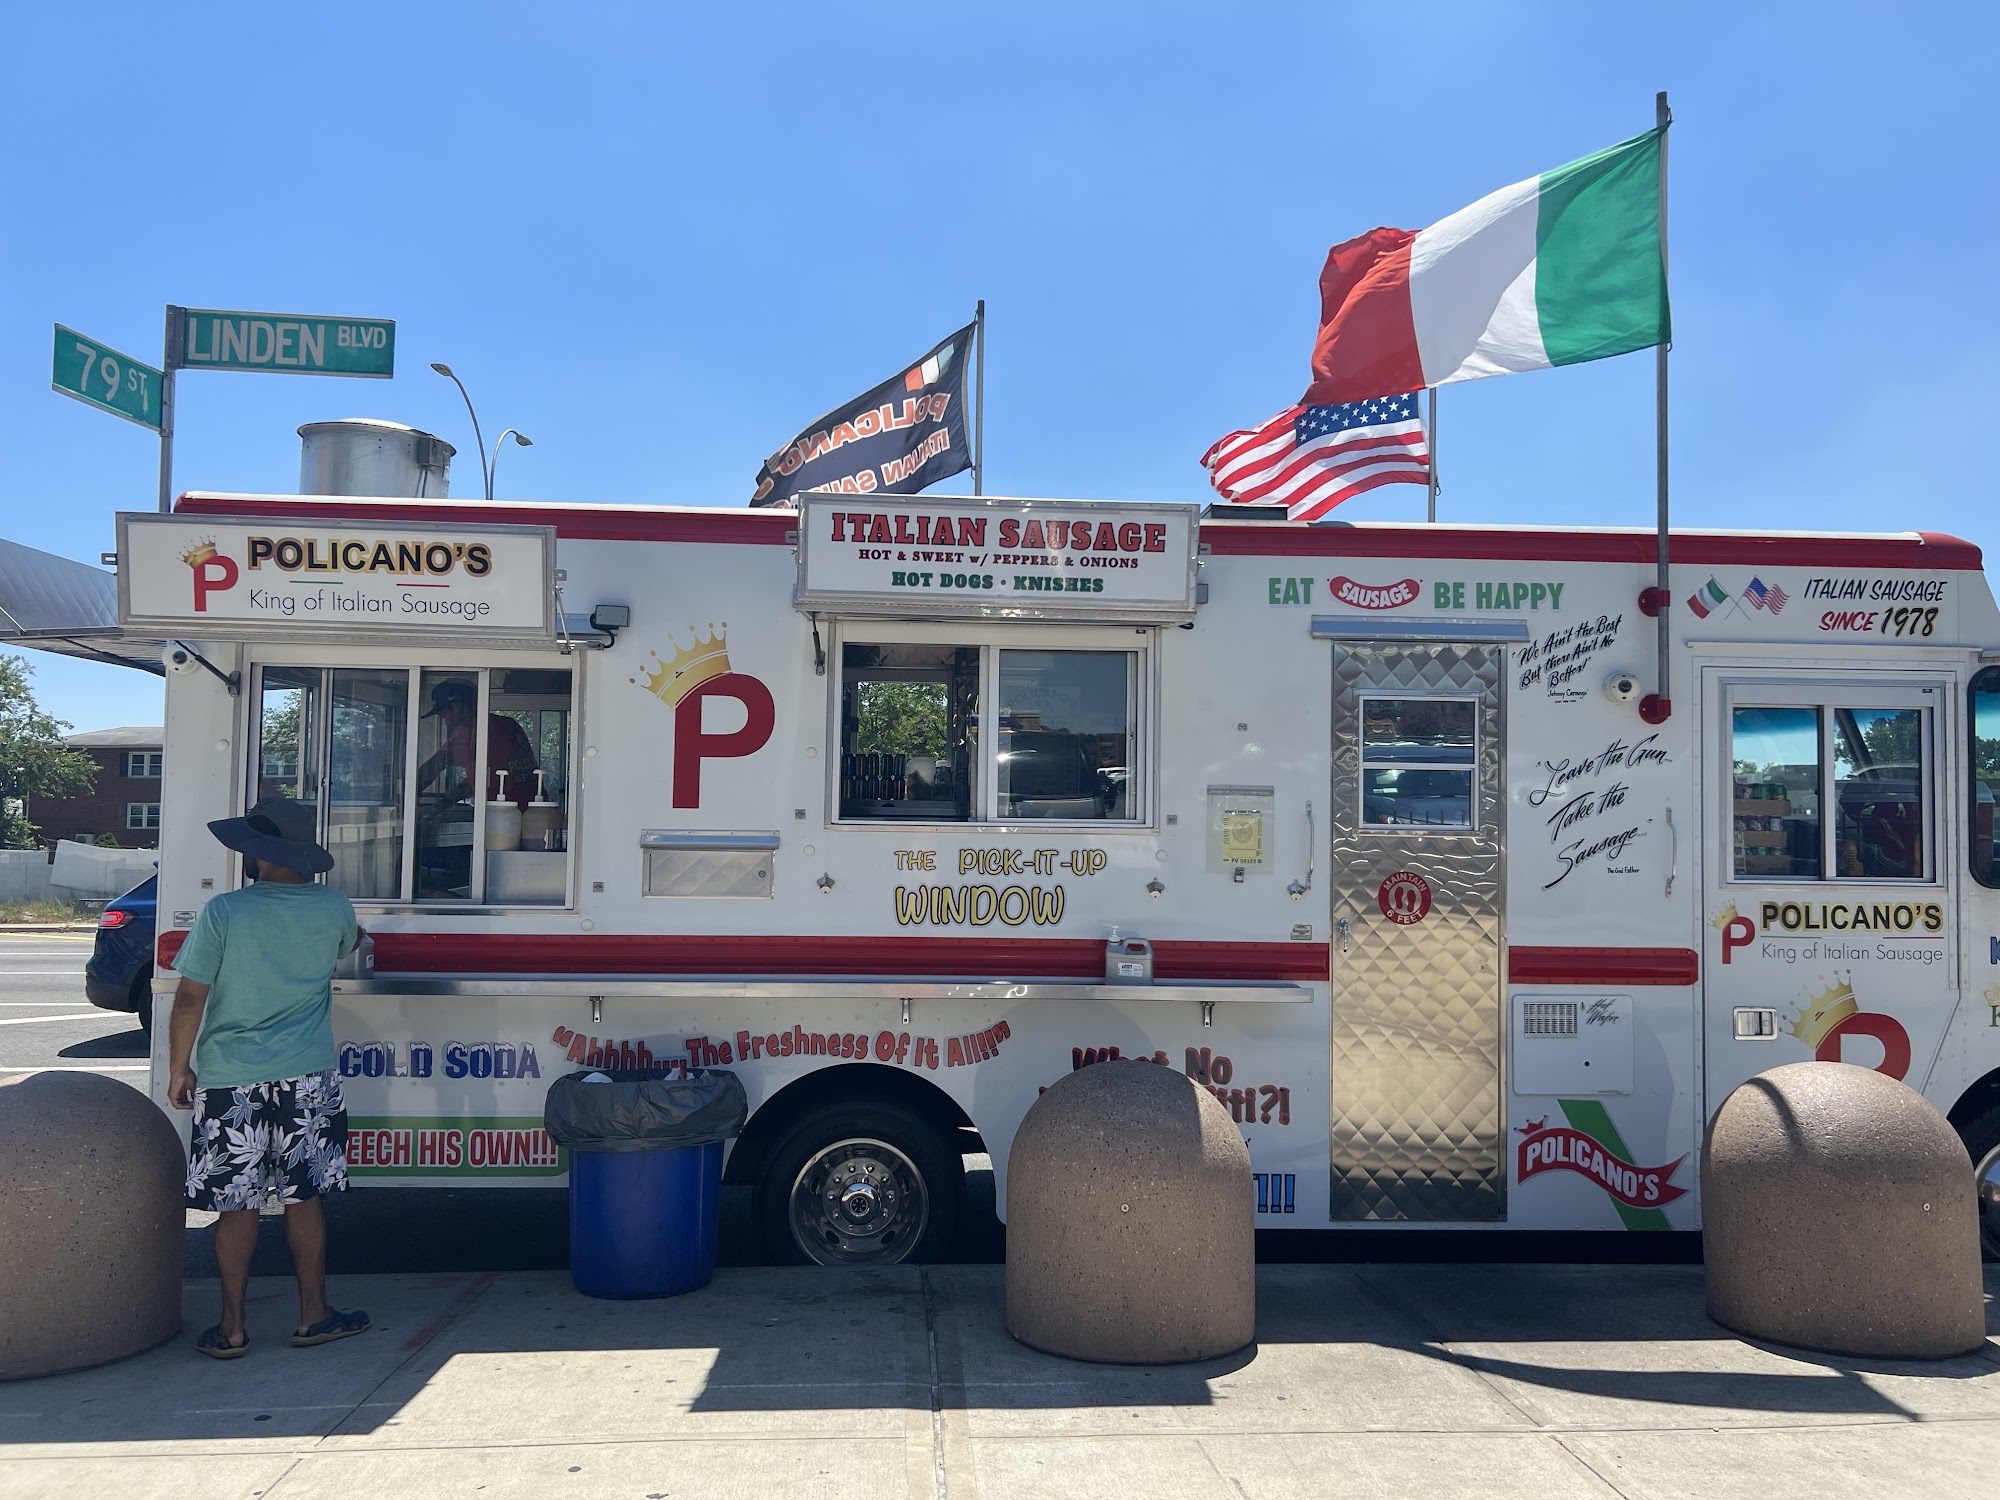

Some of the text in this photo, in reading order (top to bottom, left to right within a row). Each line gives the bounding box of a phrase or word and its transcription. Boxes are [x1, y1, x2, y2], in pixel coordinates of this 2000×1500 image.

[188, 317, 387, 367] LINDEN BLVD
[75, 342, 148, 402] 79 ST
[831, 512, 1167, 553] ITALIAN SAUSAGE
[249, 538, 491, 576] POLICANO'S
[858, 548, 1139, 569] HOT & SWEET w/ PEPPERS & ONIONS
[891, 571, 1104, 593] HOT DOGS KNISHES
[1268, 578, 1565, 610] EAT SAUSAGE BE HAPPY
[1803, 578, 1948, 602] ITALIAN SAUSAGE
[250, 589, 490, 621] King of Italian Sausage
[1818, 607, 1939, 637] SINCE 1978
[1543, 626, 1574, 653] Ain't
[1576, 621, 1595, 637] the
[1594, 614, 1622, 635] Best
[1521, 634, 1615, 688] But there Ain't No
[1596, 738, 1629, 775] the
[1548, 781, 1629, 841] Take the
[894, 848, 1107, 876] THE PICK-IT-UP
[1383, 872, 1427, 892] MAINTAIN
[895, 884, 1065, 926] WINDOW
[1386, 909, 1423, 924] 6 FEET
[1761, 902, 1943, 931] POLICANO'S
[1762, 942, 1943, 965] King of Italian Sausage
[339, 1041, 541, 1079] COLD SODA
[685, 1036, 734, 1068] The
[736, 1025, 869, 1061] Freshness
[875, 1030, 911, 1065] Of
[914, 1037, 939, 1070] It
[1184, 1047, 1233, 1085] No
[418, 1130, 462, 1166] HIS
[469, 1130, 558, 1166] OWN!!!
[1526, 1135, 1660, 1201] POLICANO'S
